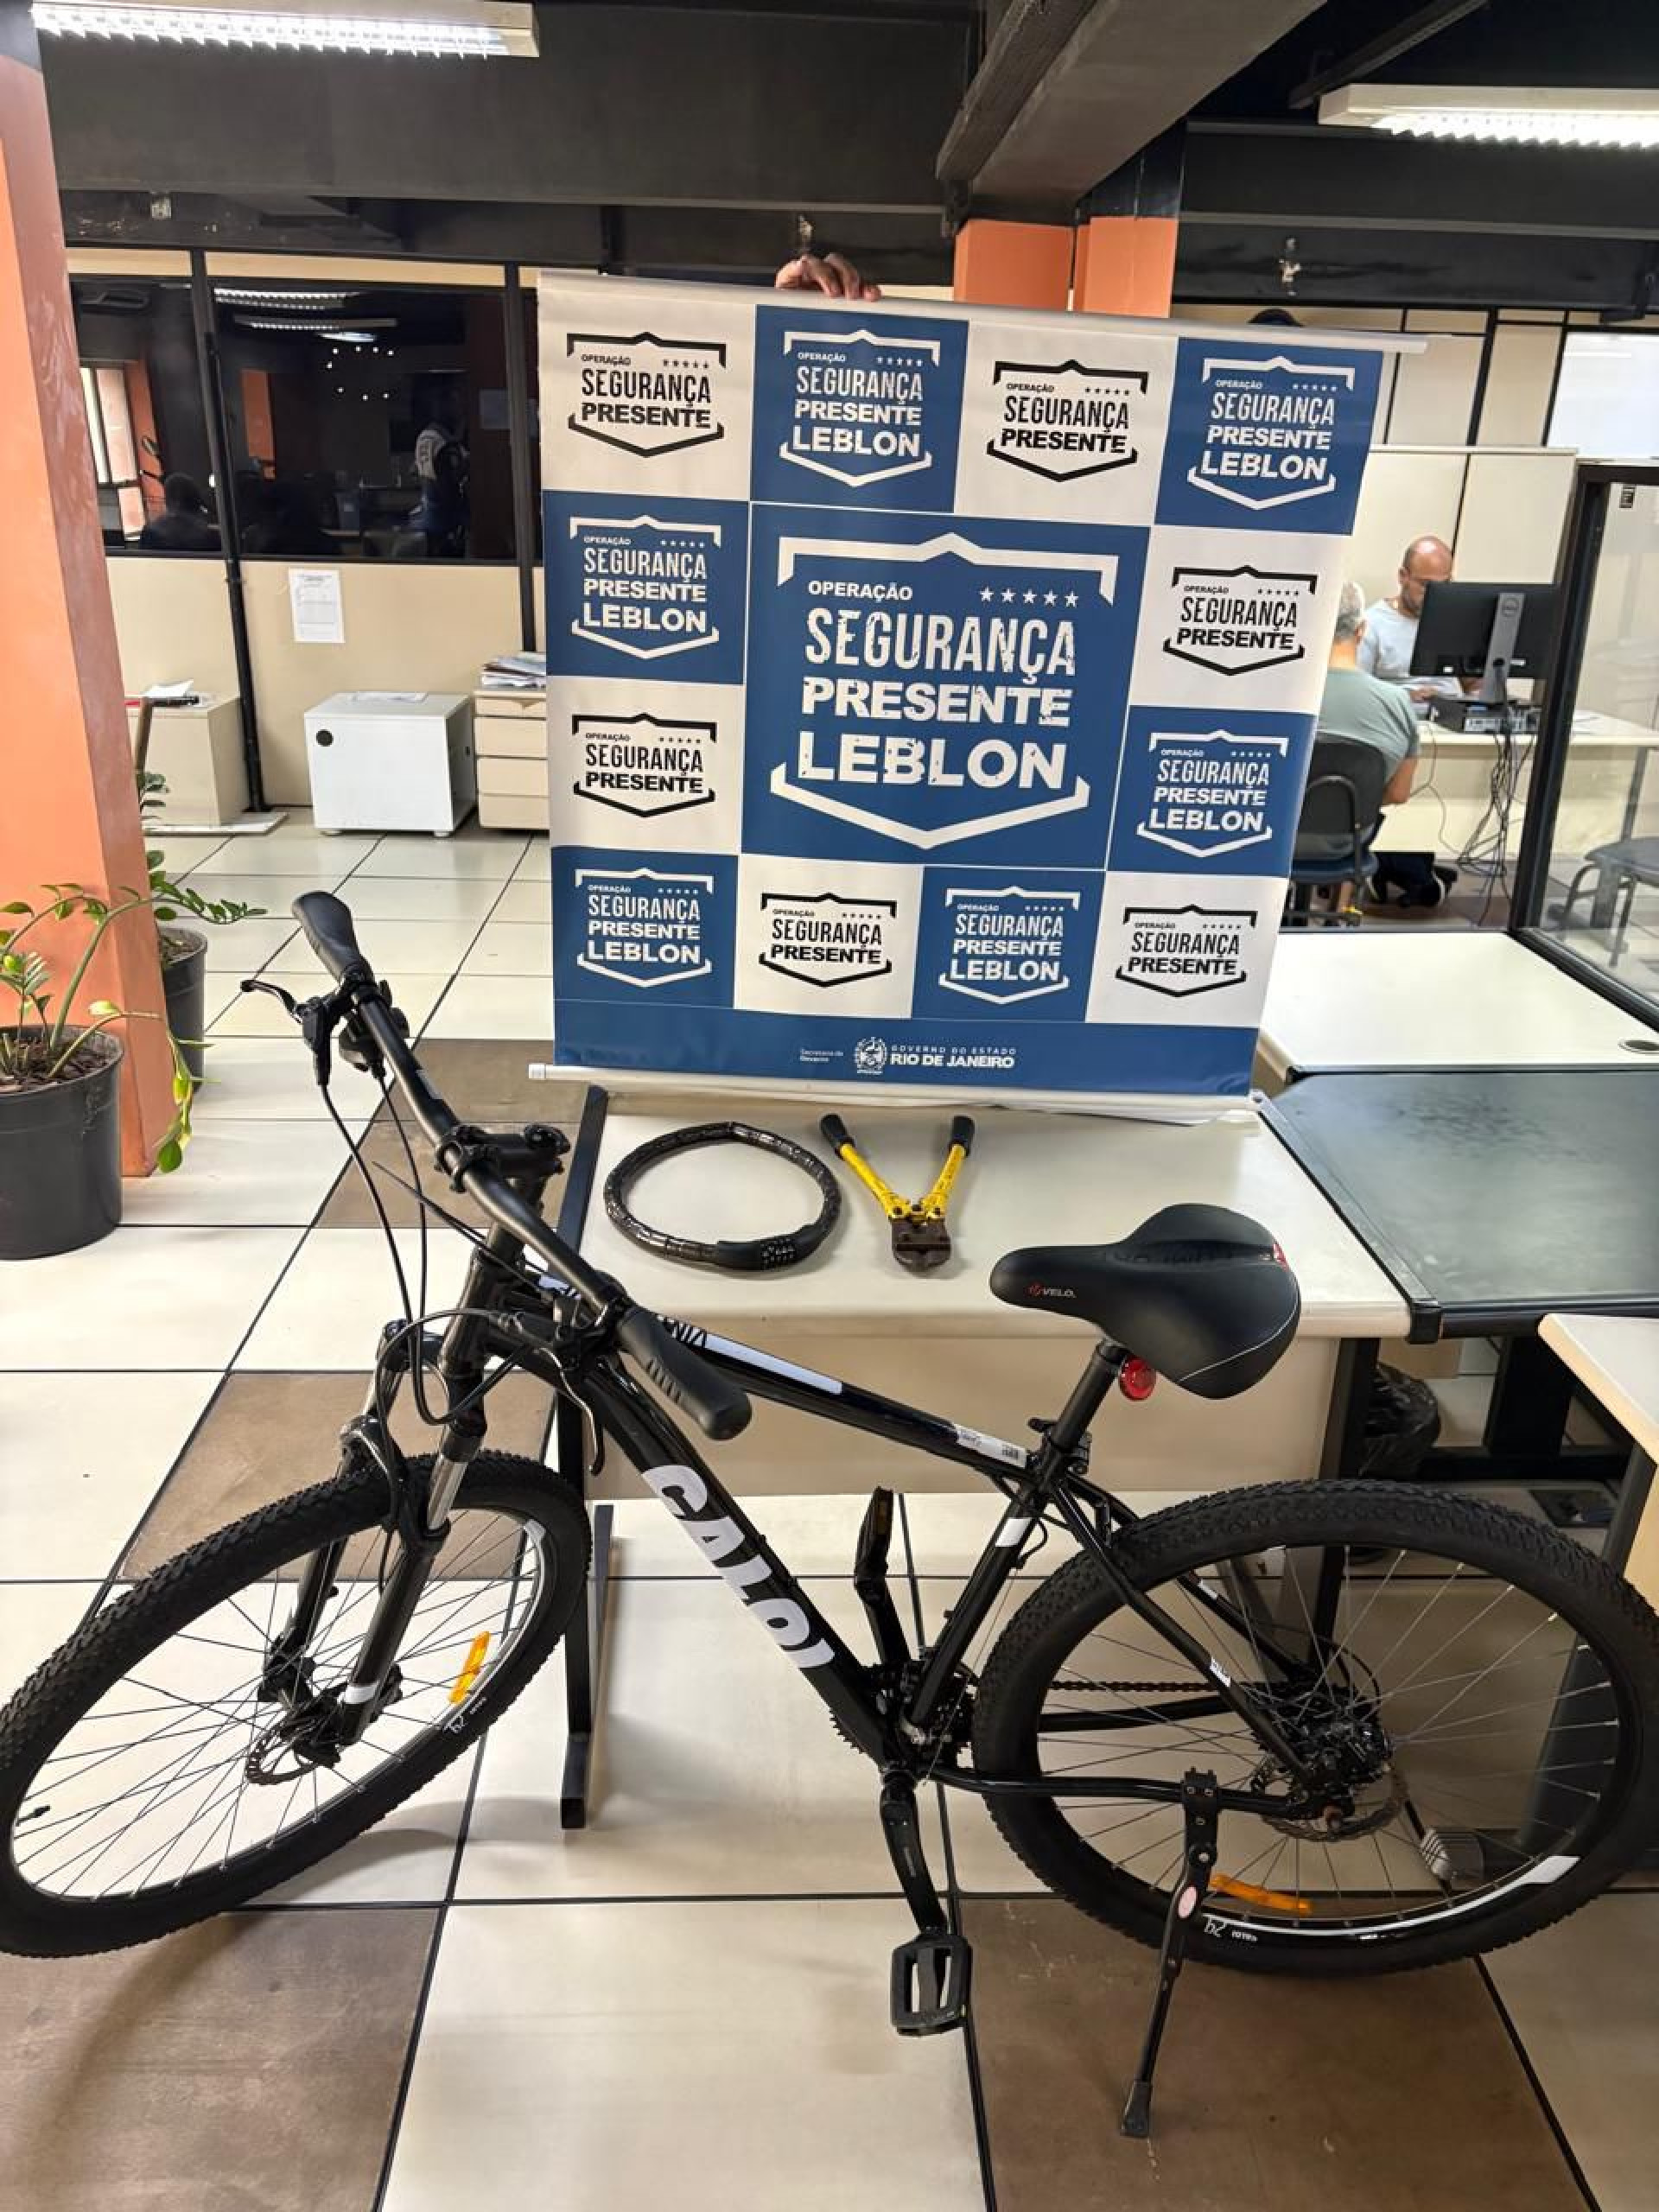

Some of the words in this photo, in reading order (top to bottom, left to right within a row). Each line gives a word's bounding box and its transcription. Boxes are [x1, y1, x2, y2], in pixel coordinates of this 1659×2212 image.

[582, 368, 711, 407] SEGURANÇA
[796, 365, 923, 405] SEGURANÇA
[582, 403, 711, 429] PRESENTE
[794, 400, 922, 427] PRESENTE
[1004, 396, 1129, 433] SEGURANÇA
[1211, 392, 1334, 430] SEGURANÇA
[792, 425, 920, 458] LEBLON
[1001, 429, 1126, 454] PRESENTE
[1207, 425, 1331, 450] PRESENTE
[1201, 450, 1327, 481] LEBLON
[583, 548, 707, 582] SEGURANÇA
[583, 578, 707, 602] PRESENTE
[807, 580, 913, 603] OPERAÇÃO
[583, 602, 706, 632] LEBLON
[1180, 596, 1297, 631] SEGURANÇA
[805, 607, 1076, 684] SEGURANÇA
[1176, 627, 1295, 650] PRESENTE
[801, 677, 1073, 728] PRESENTE
[585, 744, 702, 777] SEGURANÇA
[798, 730, 1067, 790] LEBLON
[585, 772, 703, 793] PRESENTE
[1157, 759, 1269, 789] SEGURANÇA
[1154, 786, 1266, 806] PRESENTE
[1148, 808, 1263, 832] LEBLON
[588, 894, 700, 925] SEGURANÇA
[588, 920, 700, 940] PRESENTE
[772, 918, 882, 950] SEGURANÇA
[955, 913, 1064, 942] SEGURANÇA
[588, 939, 700, 964] LEBLON
[771, 944, 881, 965] PRESENTE
[953, 939, 1062, 957] PRESENTE
[1131, 931, 1240, 958] SEGURANÇA
[950, 958, 1060, 982] LEBLON
[1128, 957, 1236, 976] PRESENTE
[890, 1053, 919, 1065] RIO
[922, 1054, 944, 1066] DE
[947, 1055, 1015, 1069] JANEIRO
[891, 1045, 946, 1053] GOVERNO
[971, 1046, 1017, 1055] ESTADO
[641, 1465, 836, 1669] CALOI
